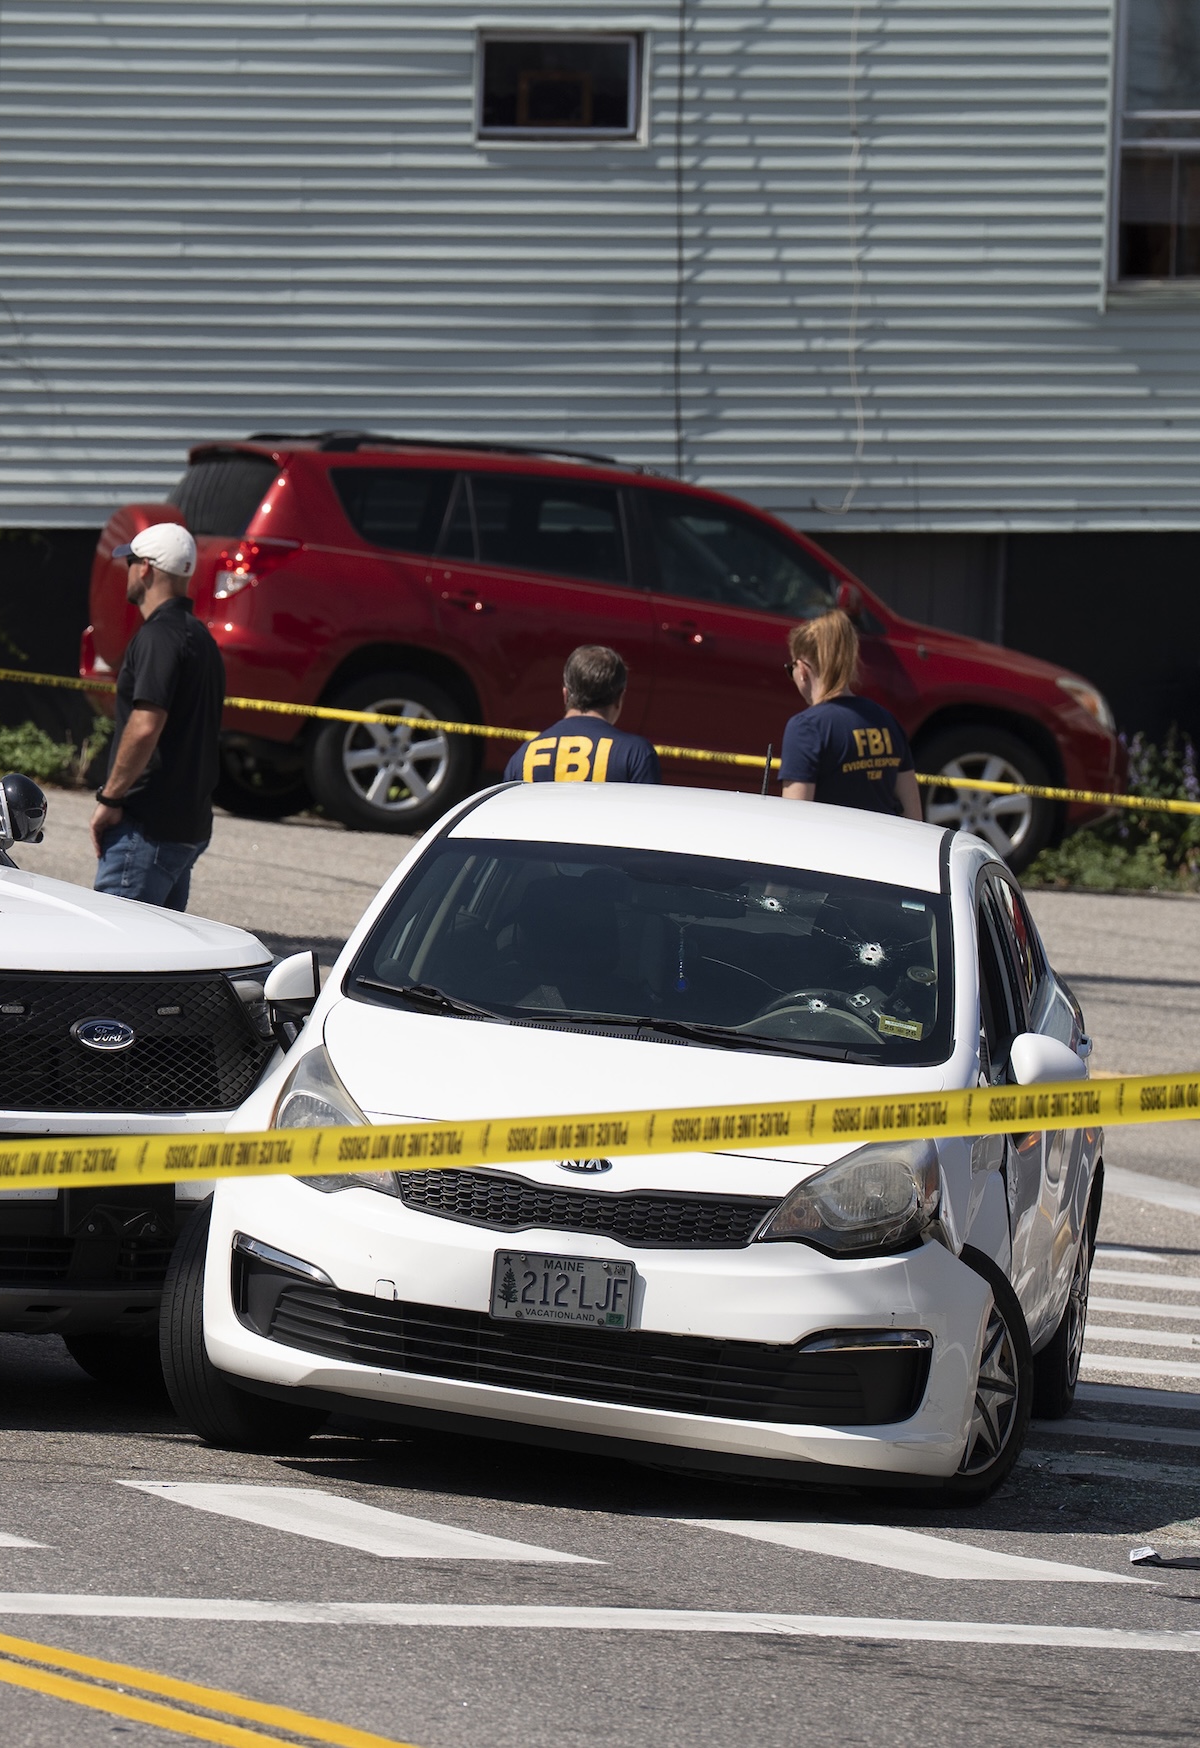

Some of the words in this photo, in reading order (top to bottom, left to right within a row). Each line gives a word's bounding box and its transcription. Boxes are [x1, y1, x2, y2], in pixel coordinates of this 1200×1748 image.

[853, 728, 893, 757] FBI
[522, 736, 613, 783] FBI
[93, 1026, 124, 1042] Ford
[1018, 1095, 1035, 1120] NOT
[1037, 1094, 1050, 1118] DO
[1051, 1092, 1069, 1118] LINE
[1071, 1090, 1101, 1115] POLICE
[1140, 1086, 1167, 1111] CROSS
[1169, 1084, 1185, 1109] NOT
[1186, 1083, 1199, 1108] DO
[832, 1107, 861, 1132] CROSS
[863, 1106, 880, 1131] NOT
[883, 1105, 895, 1129] DO
[896, 1103, 916, 1128] LINE
[918, 1101, 948, 1127] POLICE
[989, 1096, 1016, 1122] CROSS
[559, 1124, 573, 1149] DO
[574, 1123, 595, 1148] LINE
[597, 1120, 629, 1146] POLICE
[672, 1118, 702, 1143] CROSS
[703, 1116, 722, 1141] NOT
[723, 1115, 736, 1139] DO
[737, 1114, 757, 1139] LINE
[759, 1111, 790, 1137] POLICE
[338, 1136, 370, 1161] CROSS
[371, 1135, 392, 1159] NOT
[392, 1134, 407, 1158] DO
[407, 1133, 429, 1157] LINE
[430, 1130, 464, 1156] POLICE
[507, 1127, 538, 1152] CROSS
[539, 1125, 558, 1150] NOT
[20, 1152, 41, 1176] NOT
[42, 1151, 59, 1175] DO
[59, 1150, 82, 1174] LINE
[82, 1148, 120, 1172] POLICE
[165, 1144, 198, 1169] CROSS
[198, 1143, 218, 1168] NOT
[221, 1142, 236, 1166] DO
[236, 1141, 258, 1166] LINE
[259, 1139, 295, 1165] POLICE
[543, 1259, 584, 1273] MAINE
[521, 1270, 629, 1312] 212-LJF
[524, 1308, 595, 1322] VACATIONLAND
[607, 1315, 622, 1323] 27
